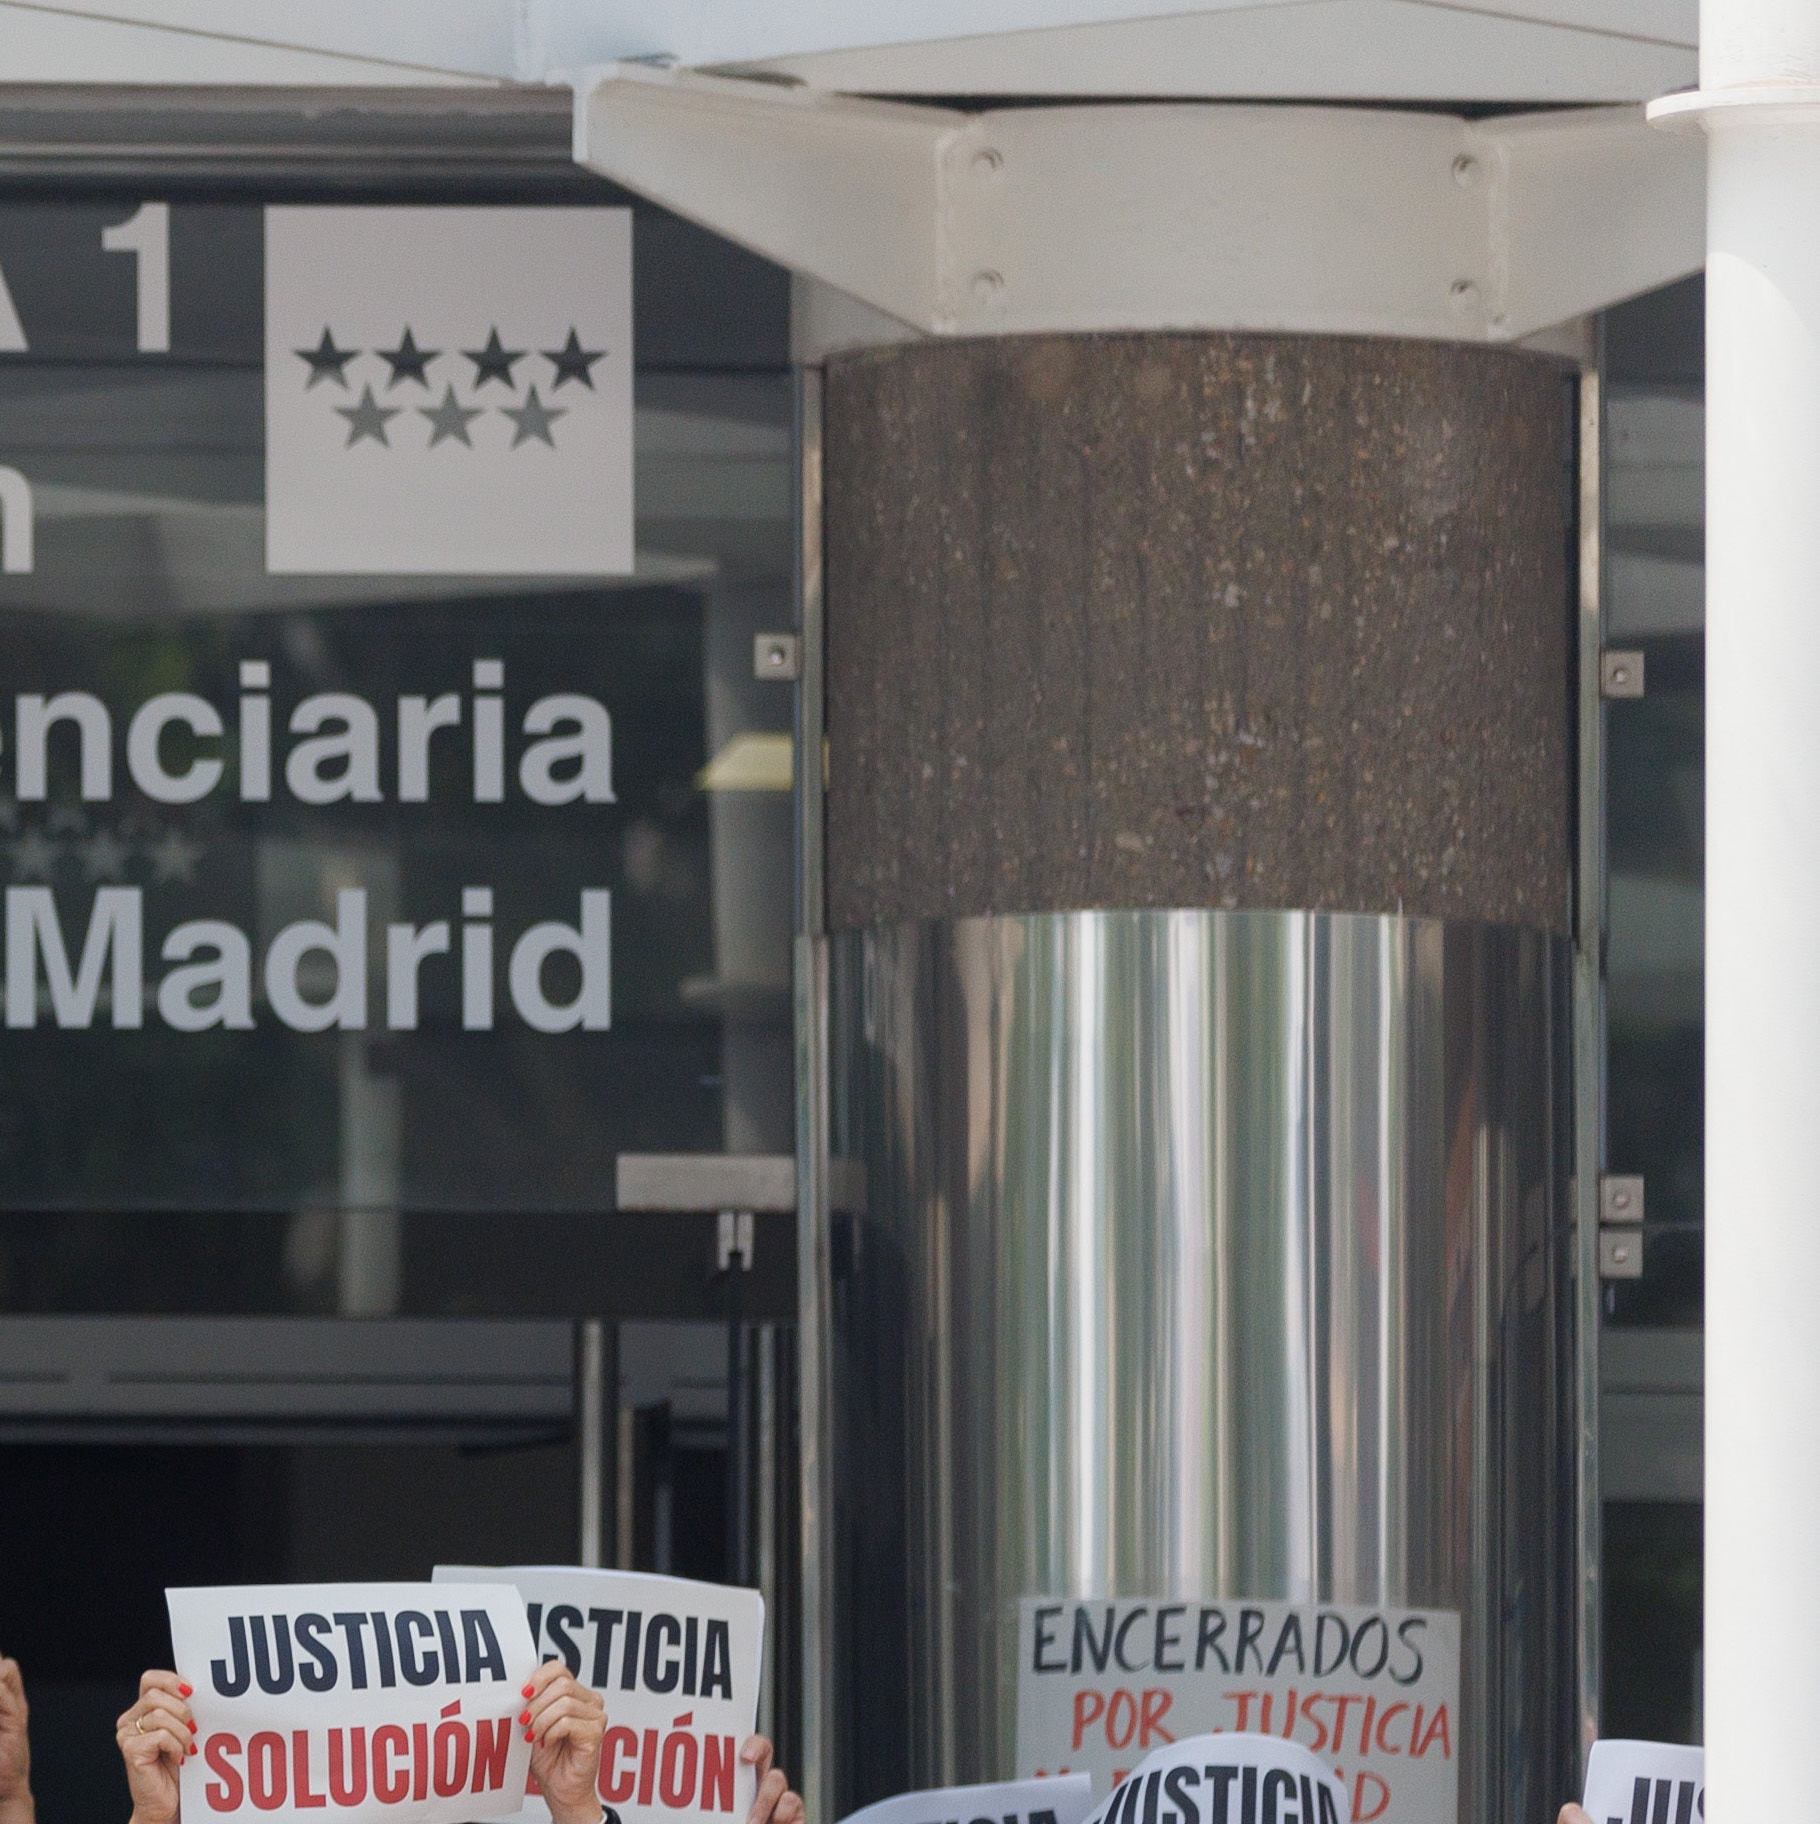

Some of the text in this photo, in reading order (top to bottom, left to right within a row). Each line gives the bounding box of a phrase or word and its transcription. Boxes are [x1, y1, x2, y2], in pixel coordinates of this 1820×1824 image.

[102, 203, 170, 353] 1
[6, 889, 611, 1034] Madrid
[210, 1608, 508, 1699] JUSTICIA
[526, 1602, 733, 1700] STICIA
[1031, 1605, 1428, 1685] ENCERRADOS
[203, 1699, 512, 1813] SOLUCIÓN
[1072, 1688, 1176, 1752] POR
